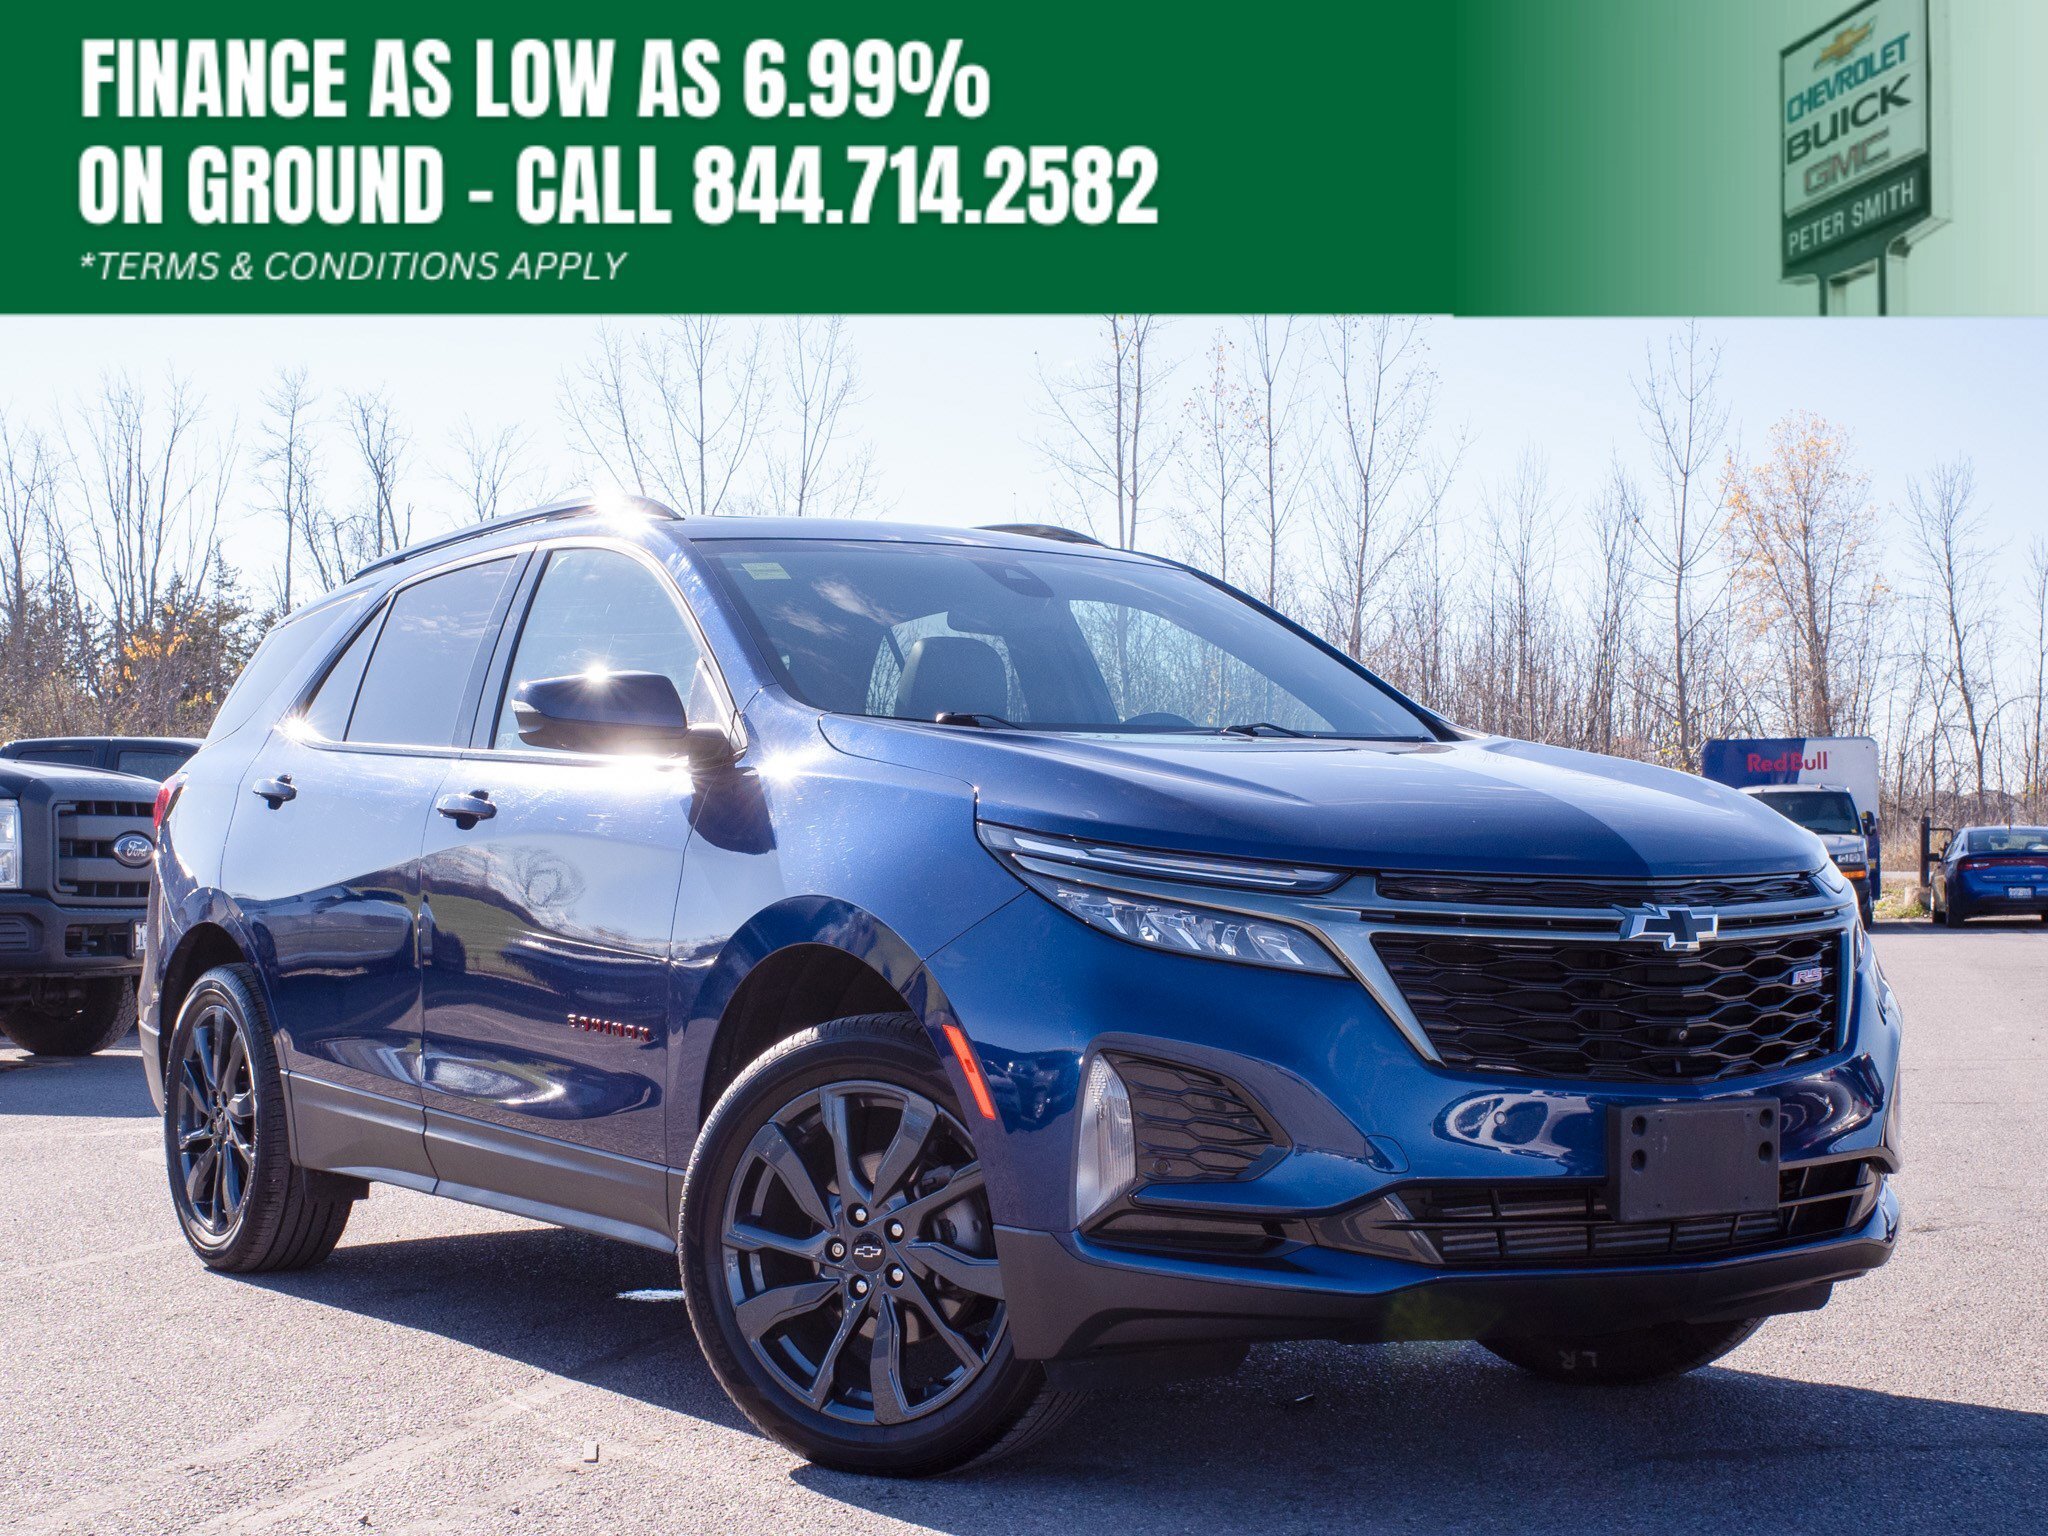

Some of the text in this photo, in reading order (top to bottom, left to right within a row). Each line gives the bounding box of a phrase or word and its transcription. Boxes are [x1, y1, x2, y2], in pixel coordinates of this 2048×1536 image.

[1747, 751, 1828, 773] Red Bull
[126, 840, 148, 858] Ford
[1792, 967, 1823, 986] RS
